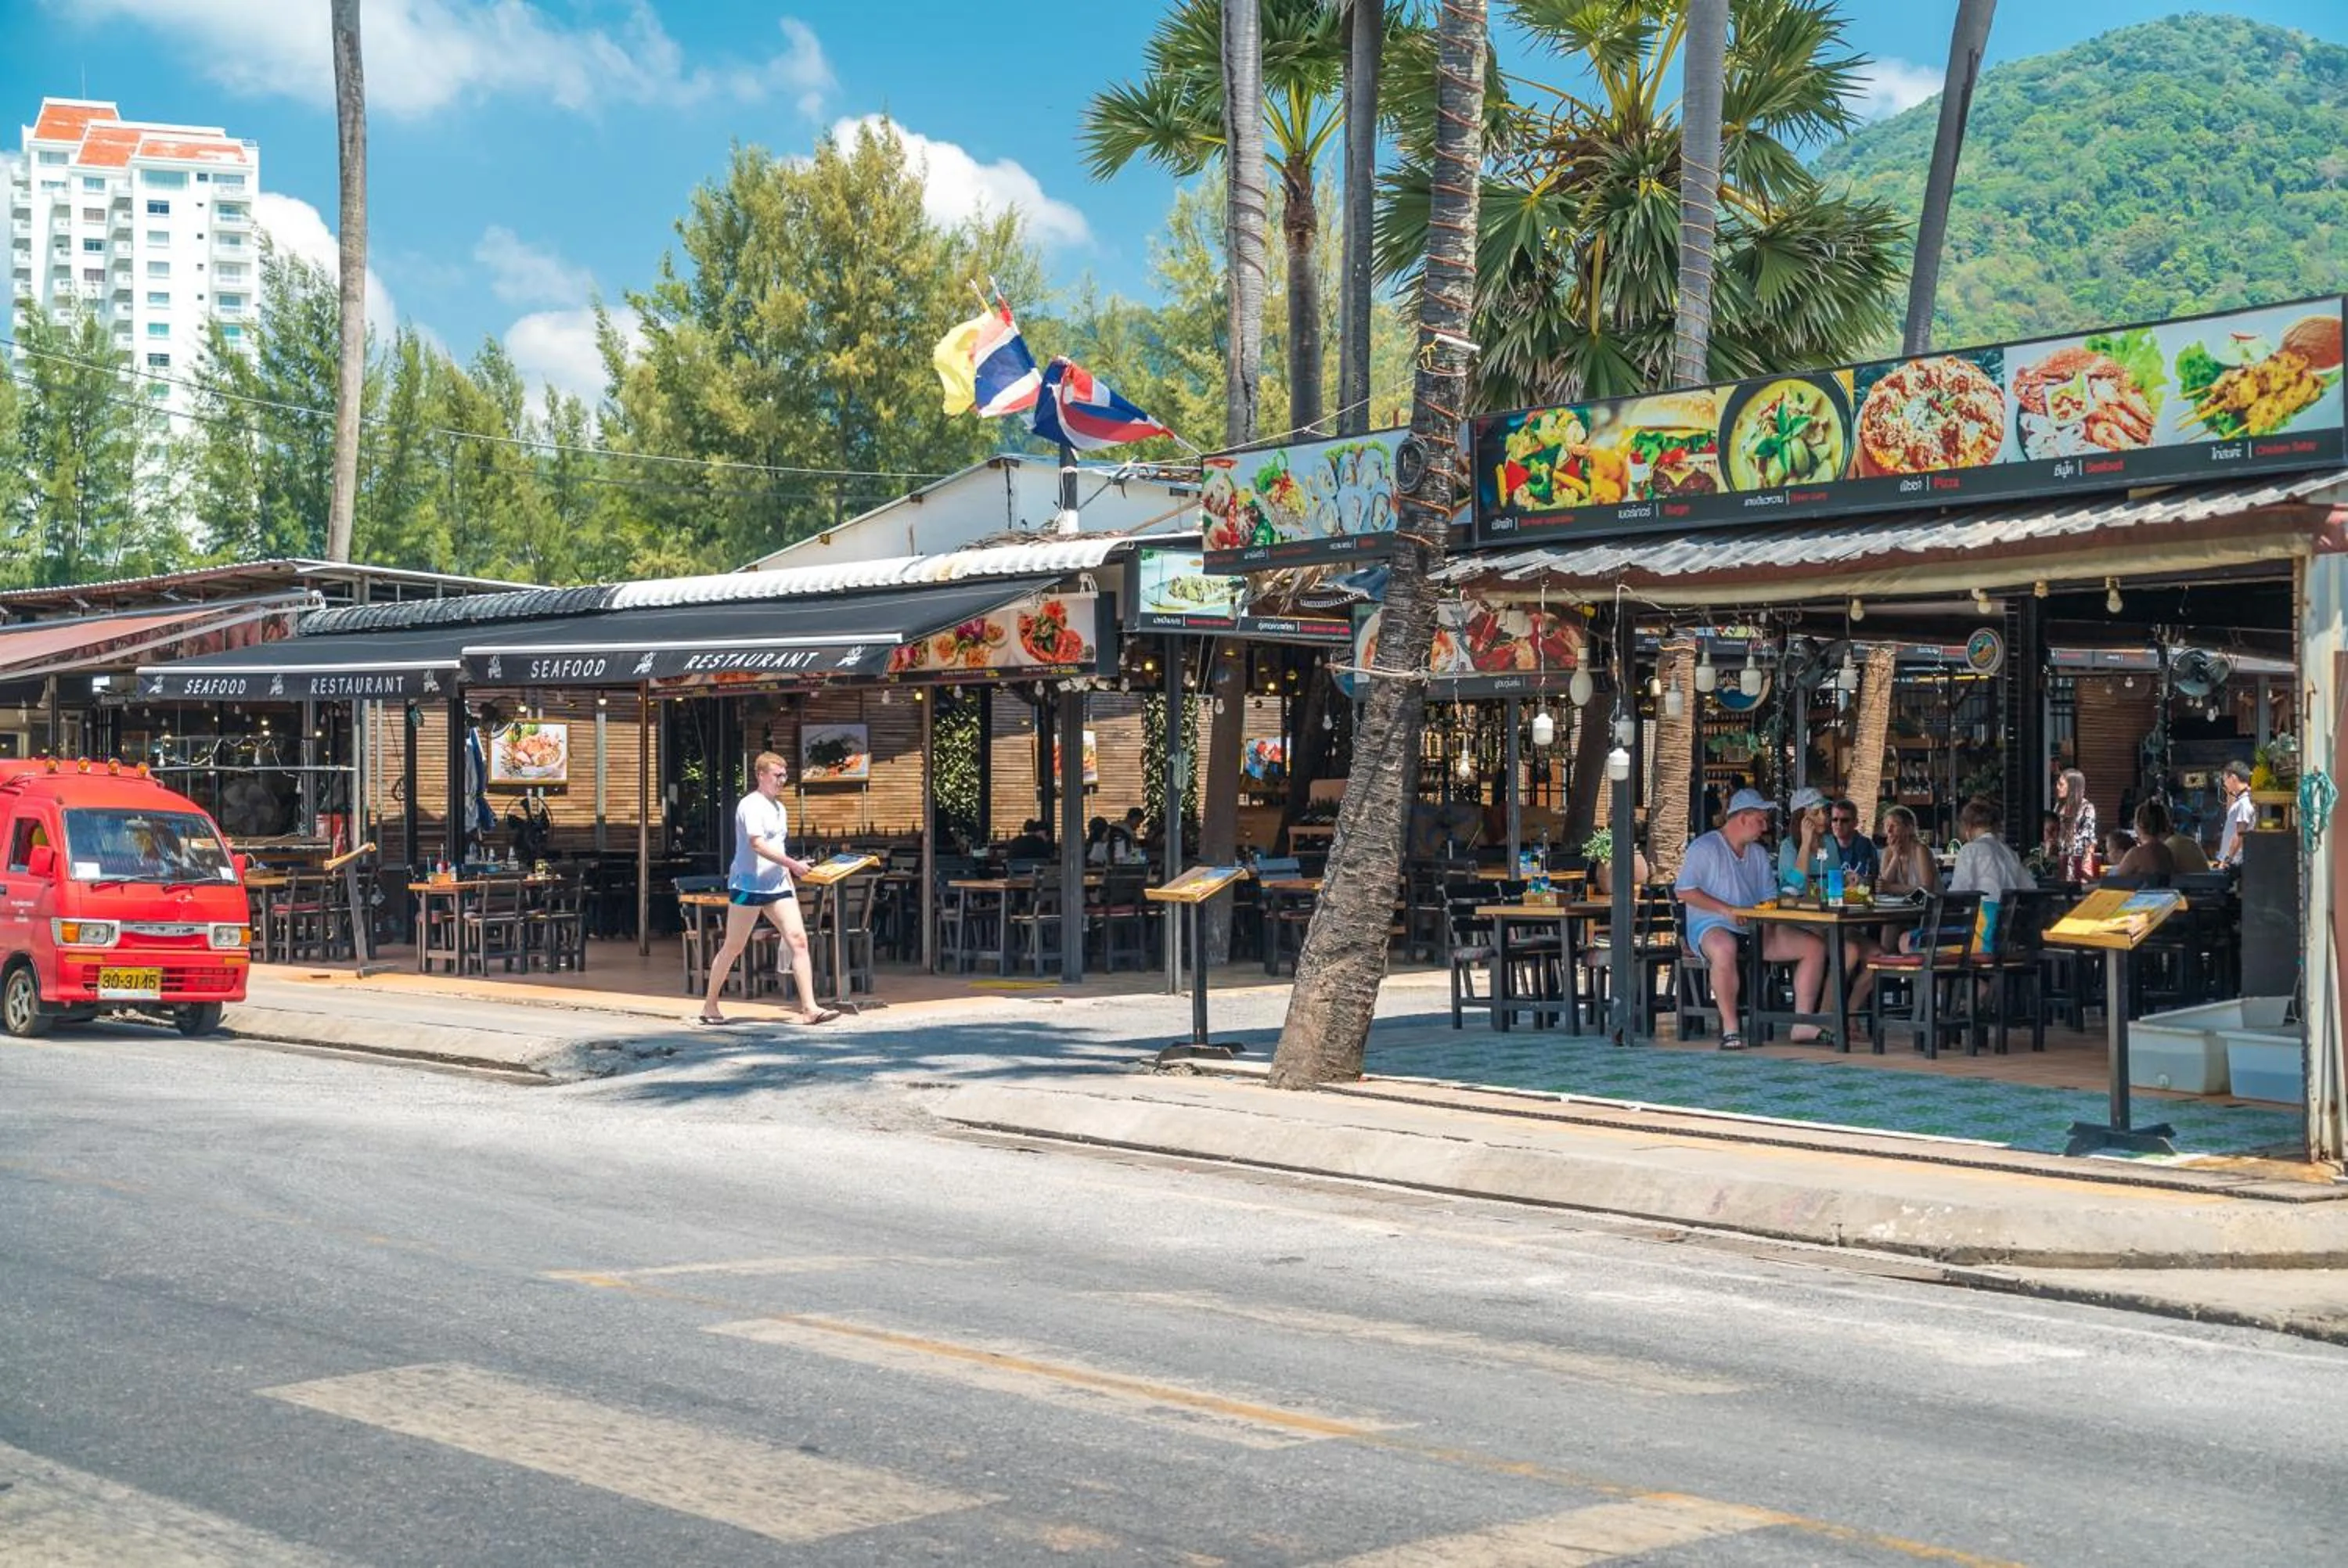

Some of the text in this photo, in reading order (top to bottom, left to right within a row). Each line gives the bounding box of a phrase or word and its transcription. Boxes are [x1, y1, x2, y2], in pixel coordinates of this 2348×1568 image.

[1933, 476, 1960, 489] Pizza
[531, 652, 819, 678] SEAFOOD RESTAURANT
[184, 676, 404, 695] SEAFOOD RESTAURANT
